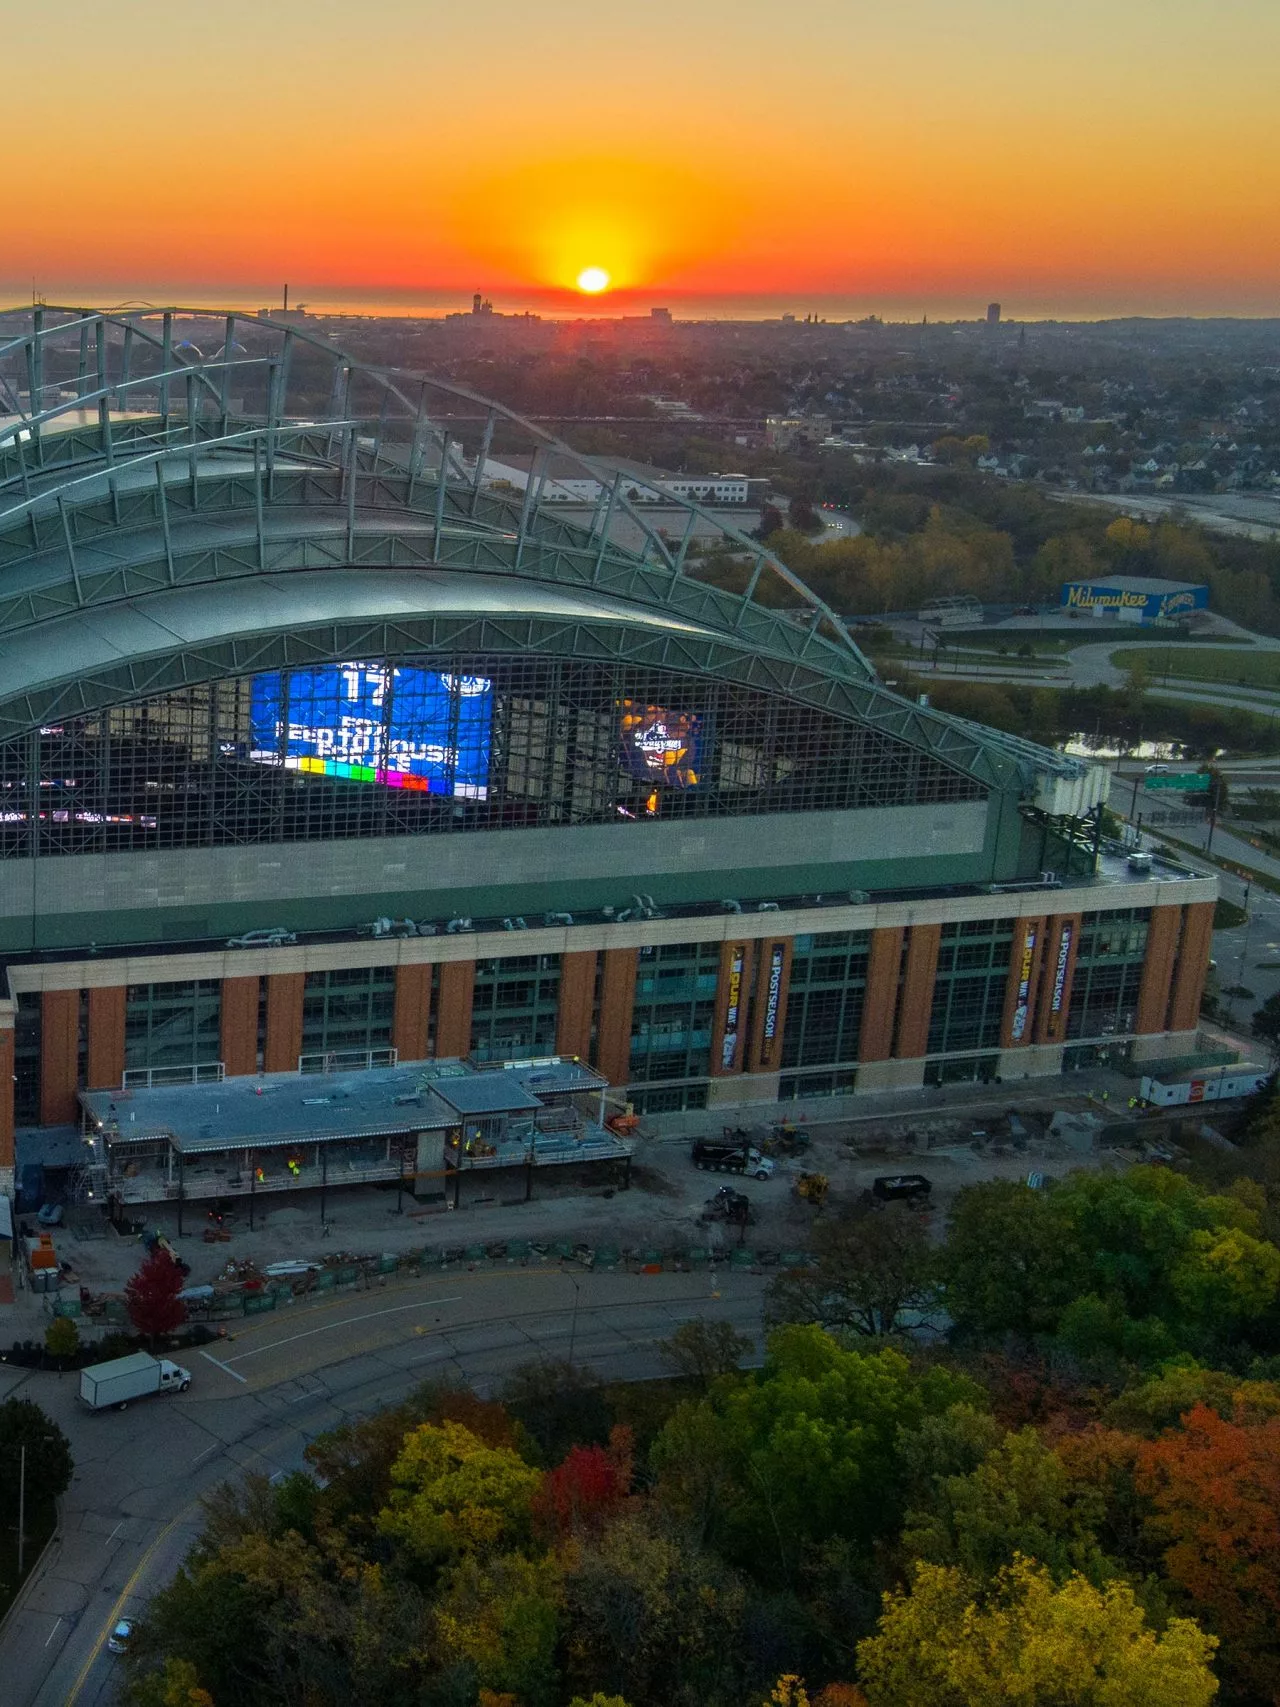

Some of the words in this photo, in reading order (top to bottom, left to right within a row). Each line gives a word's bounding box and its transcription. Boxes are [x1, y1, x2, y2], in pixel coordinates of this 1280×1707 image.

[1020, 948, 1032, 982] OUR
[1051, 942, 1069, 1011] POSTSEASON
[729, 972, 741, 1007] OUR
[765, 966, 781, 1038] POSTSEASON
[727, 1007, 738, 1024] WAY
